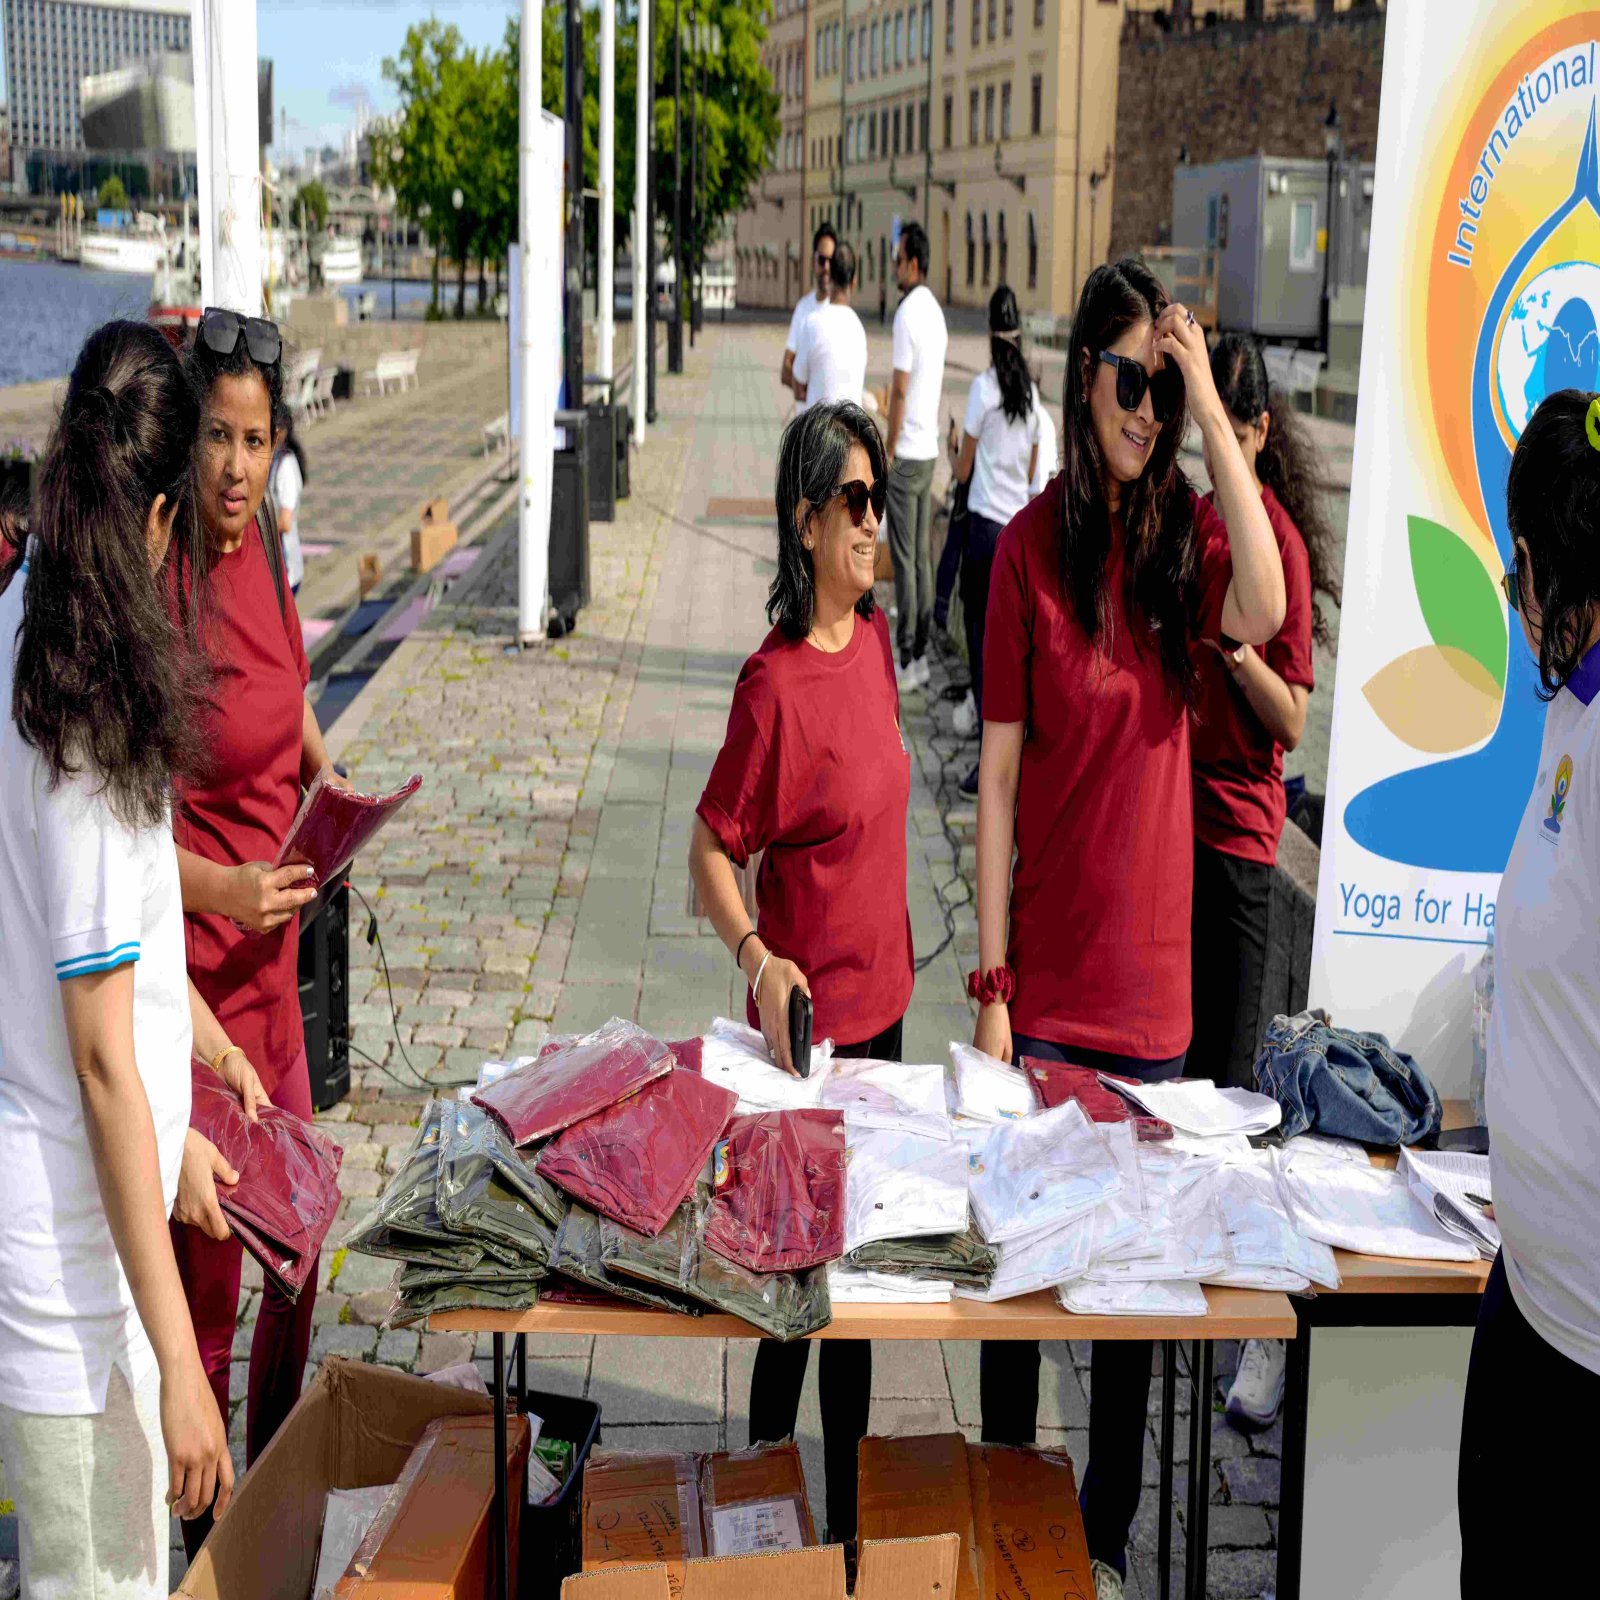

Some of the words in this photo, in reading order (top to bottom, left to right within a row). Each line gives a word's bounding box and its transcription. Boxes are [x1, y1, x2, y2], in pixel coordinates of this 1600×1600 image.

[1448, 41, 1595, 267] International
[1340, 882, 1401, 928] Yoga
[1415, 888, 1452, 924] for
[1463, 892, 1497, 927] Ha
